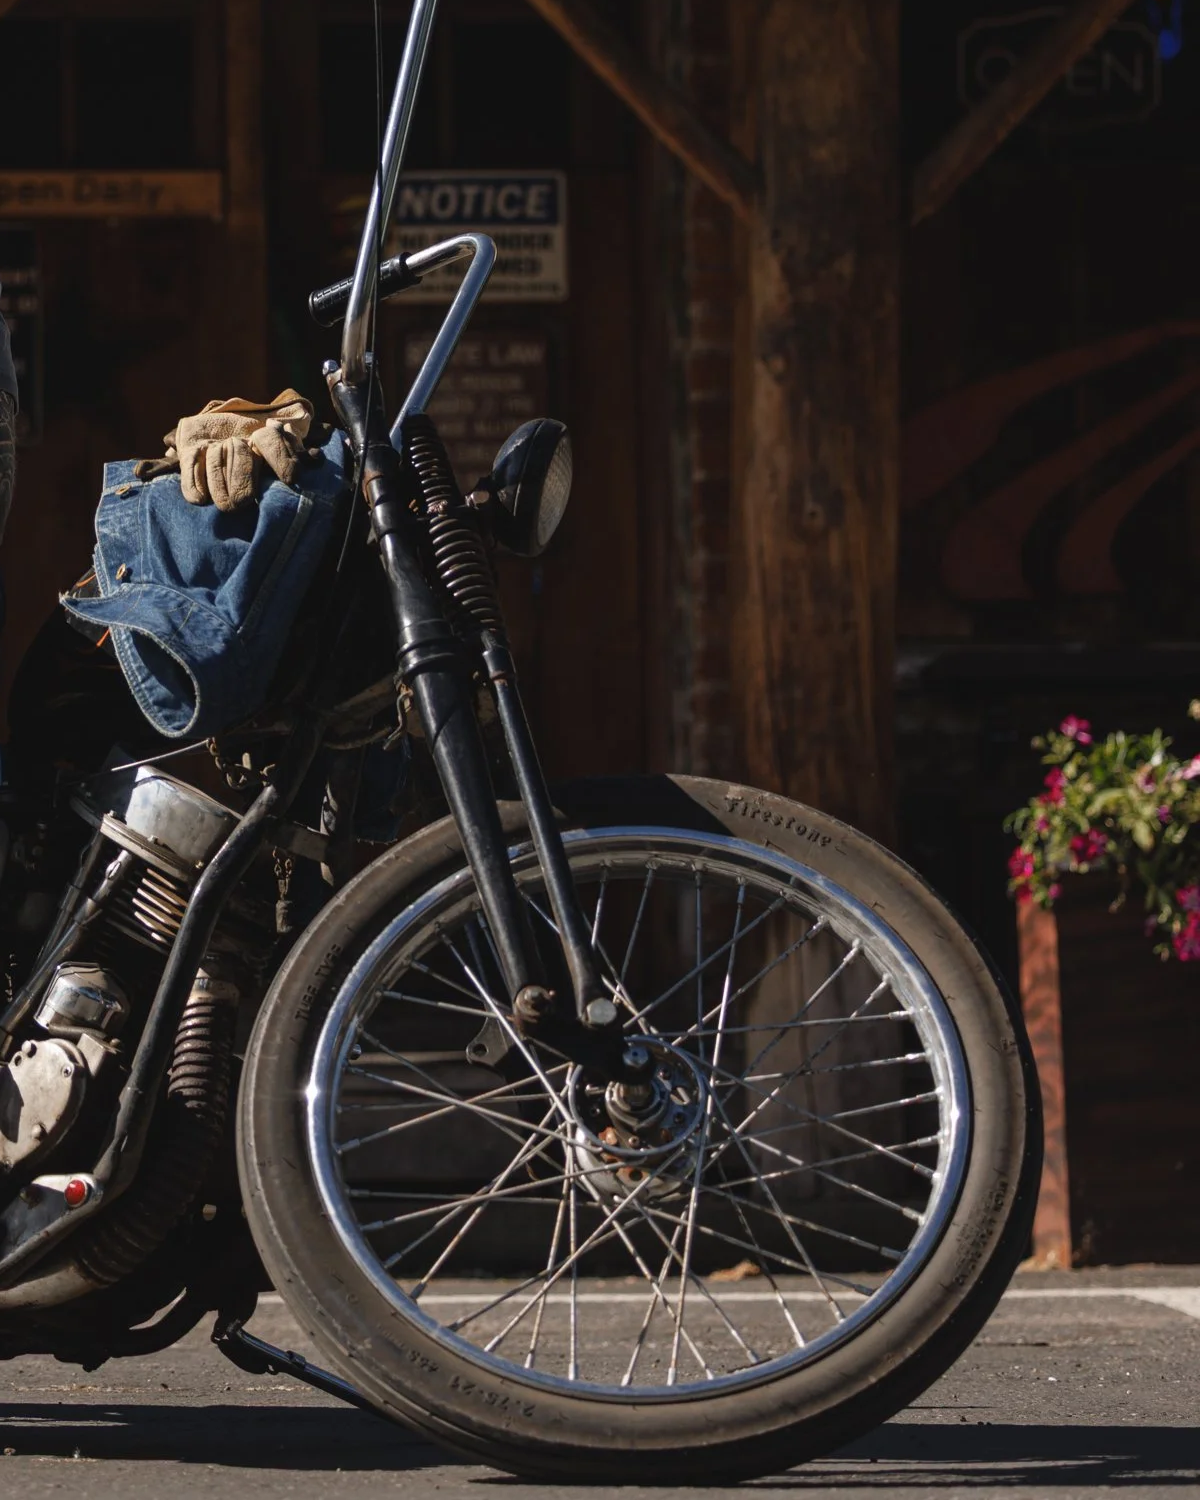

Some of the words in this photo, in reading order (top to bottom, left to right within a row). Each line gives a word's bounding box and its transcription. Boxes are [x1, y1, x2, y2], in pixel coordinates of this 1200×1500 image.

[974, 46, 1145, 95] OEN
[396, 183, 551, 219] NOTICE
[724, 797, 832, 847] Firestone
